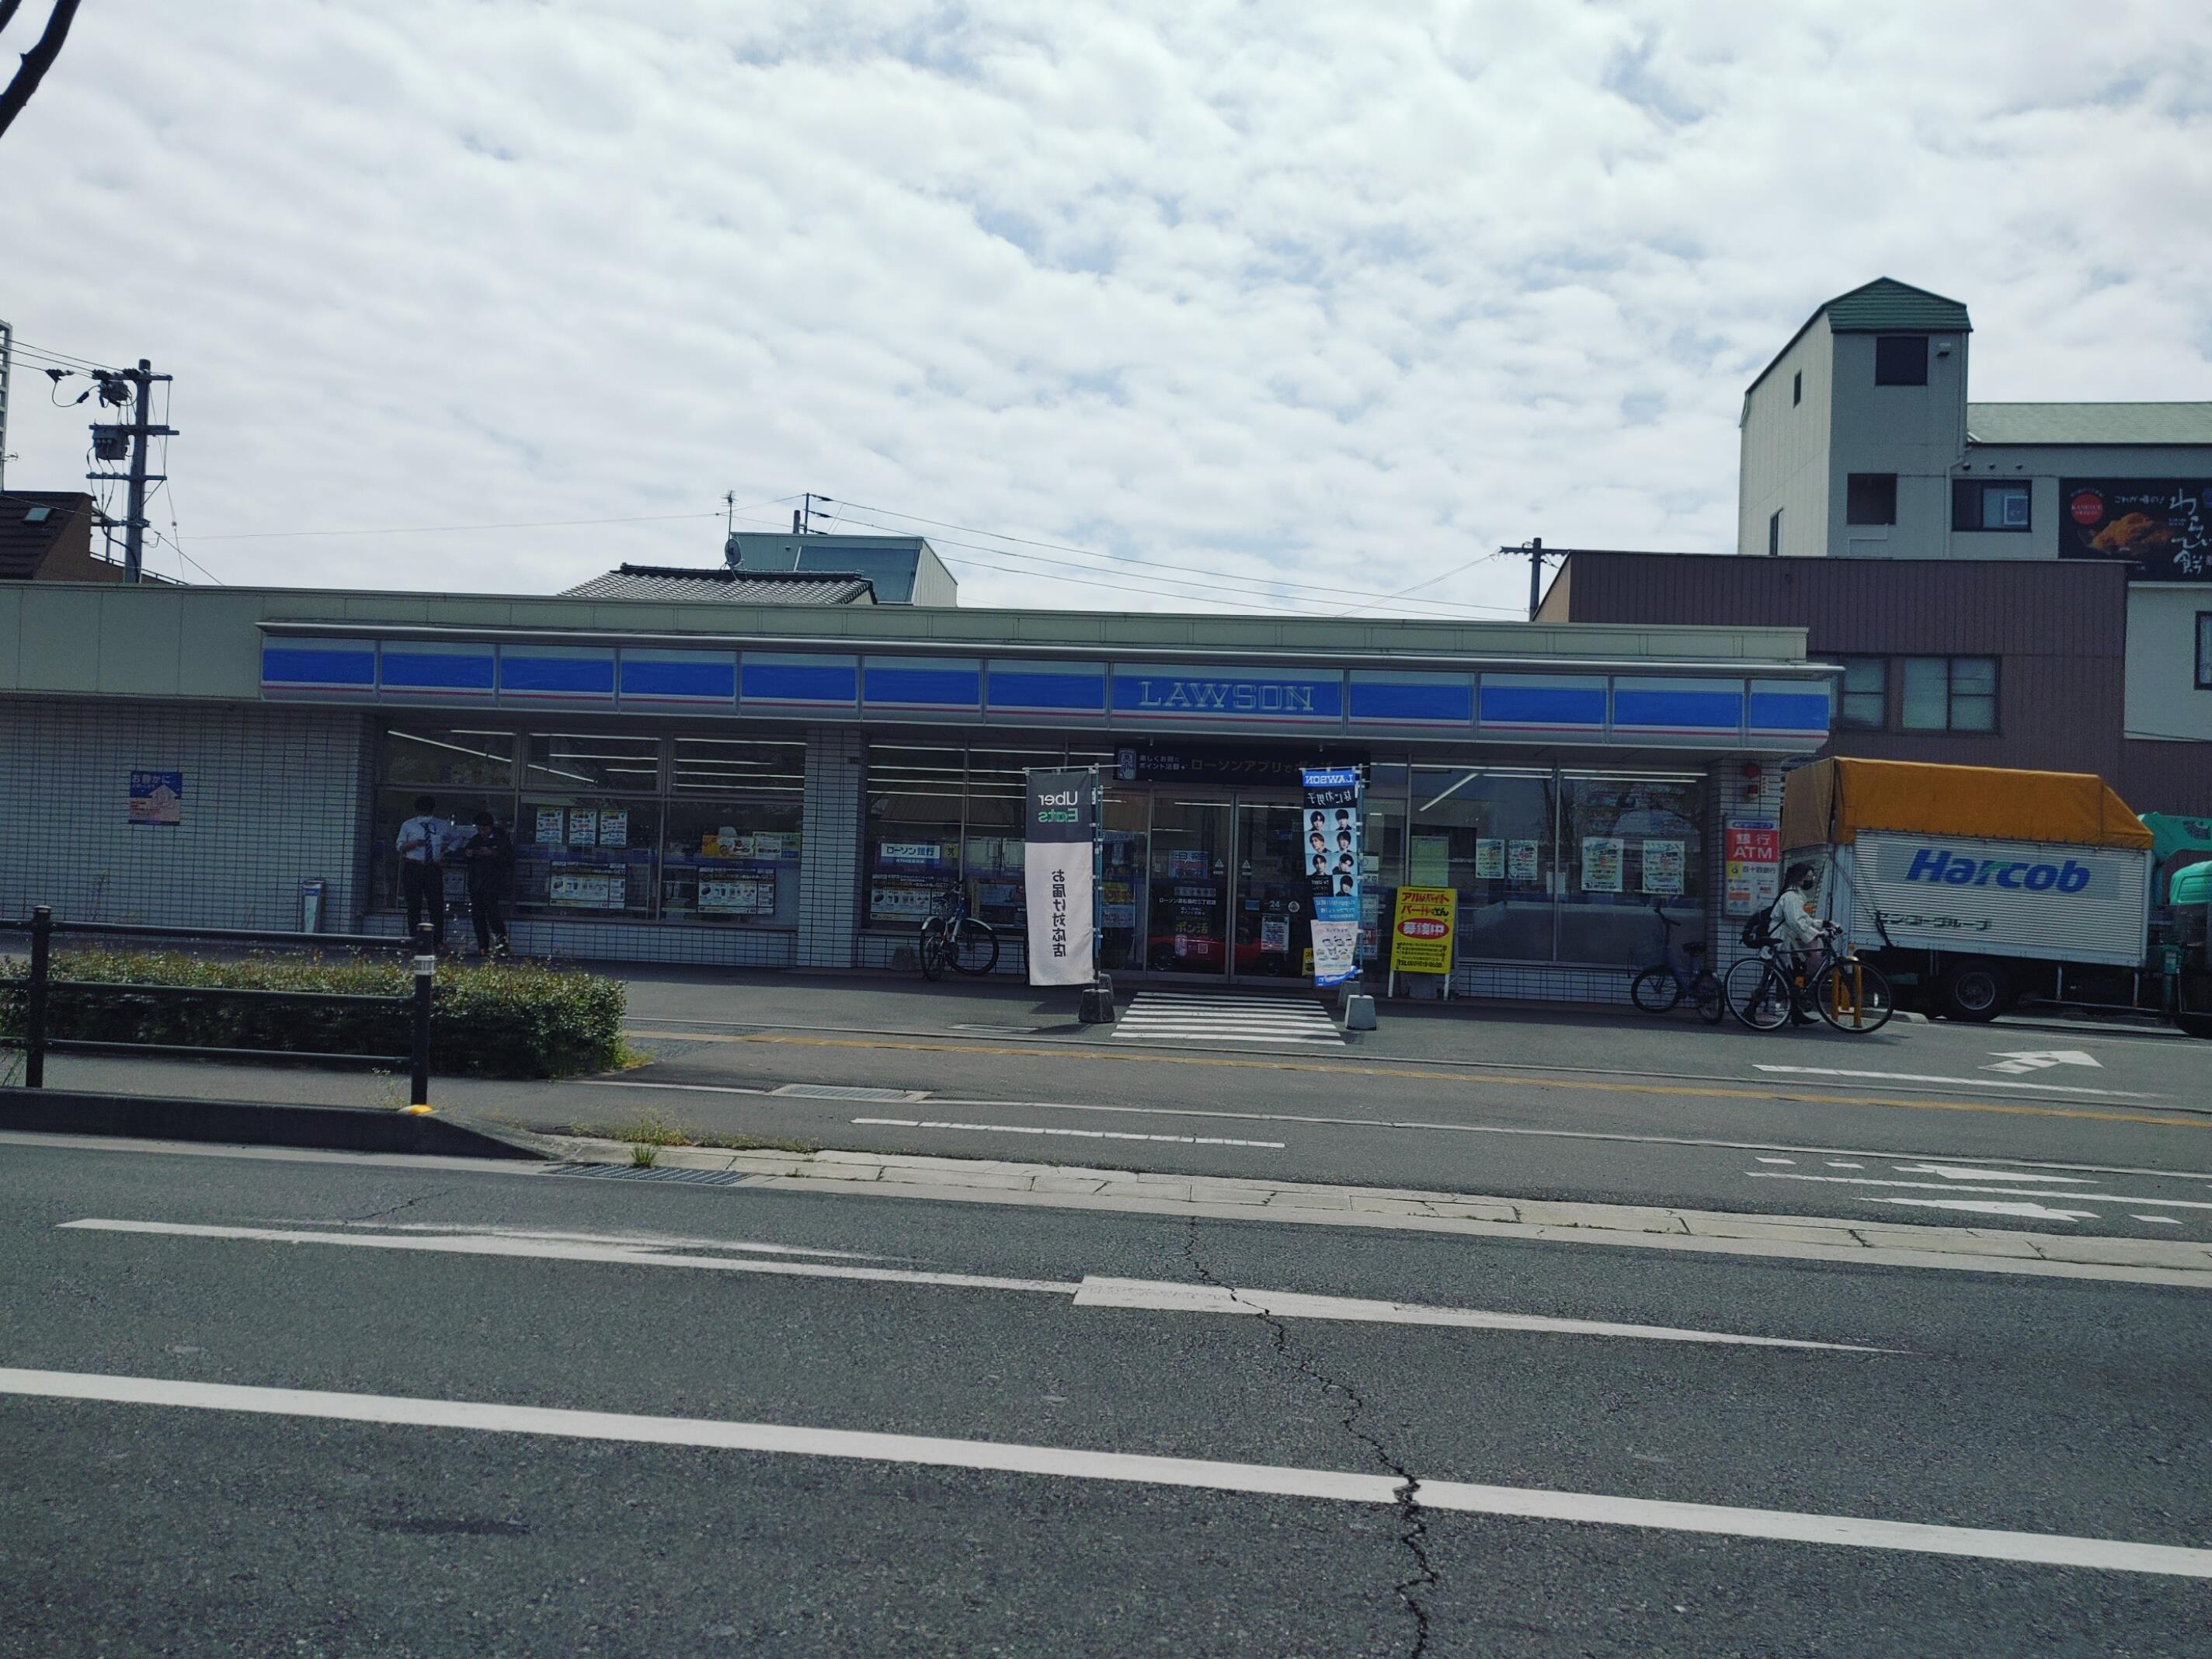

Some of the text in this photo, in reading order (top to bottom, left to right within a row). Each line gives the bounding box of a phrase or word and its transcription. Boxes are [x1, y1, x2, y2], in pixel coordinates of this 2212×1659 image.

[1138, 680, 1314, 711] LAWSON
[1736, 833, 1771, 845] 銀行
[886, 846, 935, 857] ローソン銀行
[1734, 847, 1772, 859] ATM
[1905, 849, 2091, 892] Harcob
[1401, 892, 1450, 904] アルバイト
